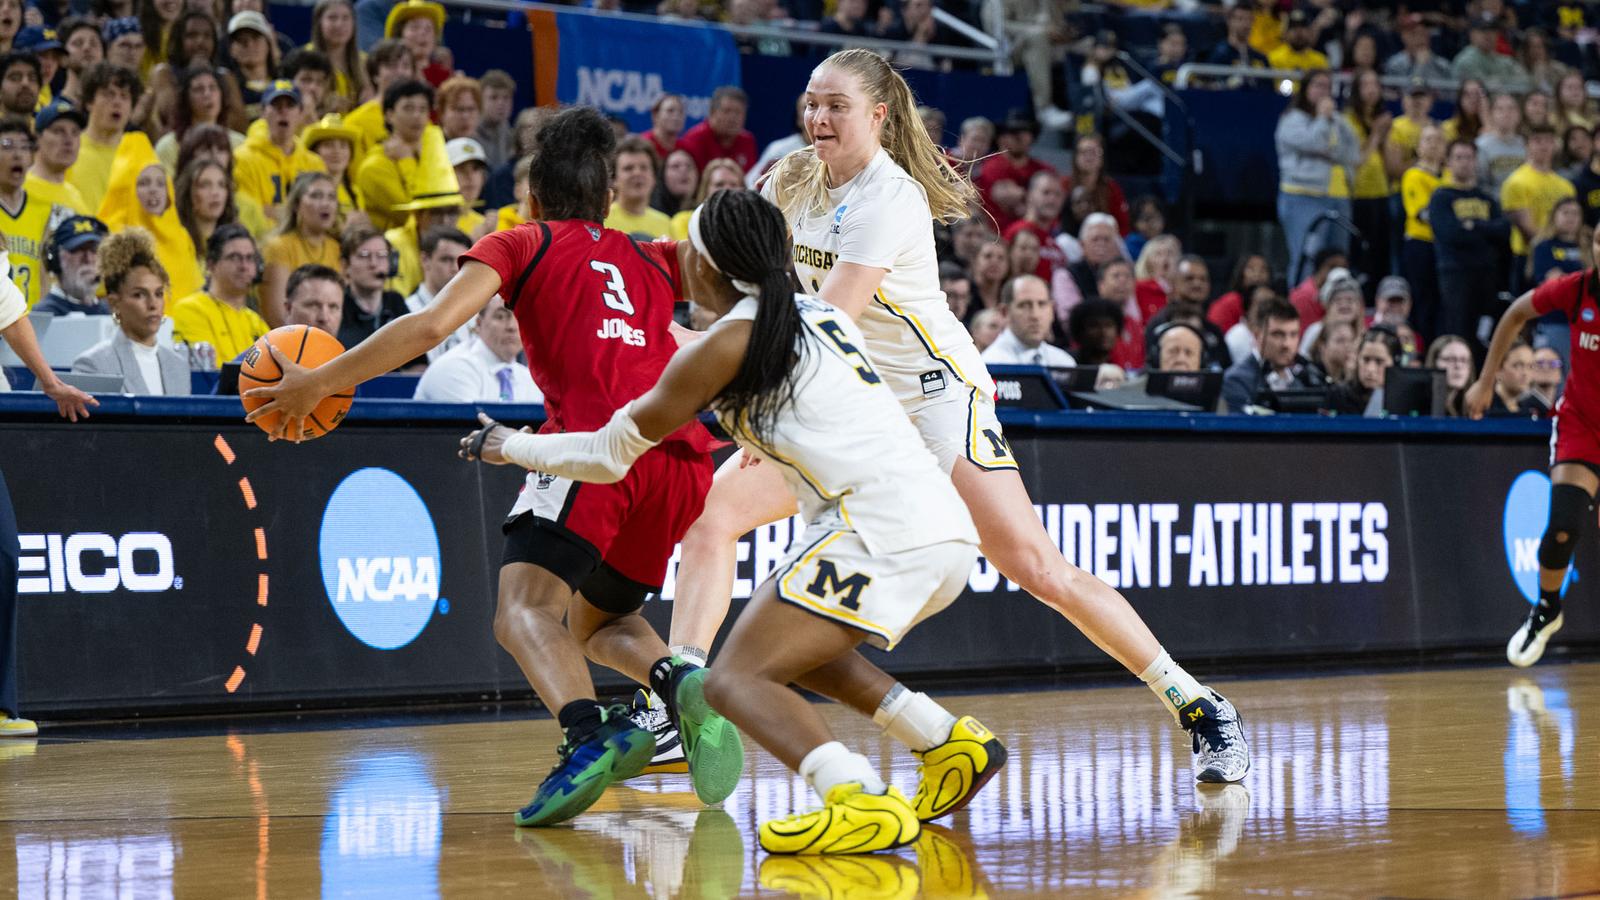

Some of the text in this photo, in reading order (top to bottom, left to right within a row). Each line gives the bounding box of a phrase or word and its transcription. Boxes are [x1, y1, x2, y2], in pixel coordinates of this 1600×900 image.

[576, 65, 665, 114] NCAA
[590, 259, 635, 316] 3
[815, 318, 882, 385] 5
[924, 372, 938, 380] 44
[17, 533, 175, 593] EICO
[336, 556, 439, 603] NCAA
[806, 558, 872, 612] M
[1187, 706, 1205, 722] M
